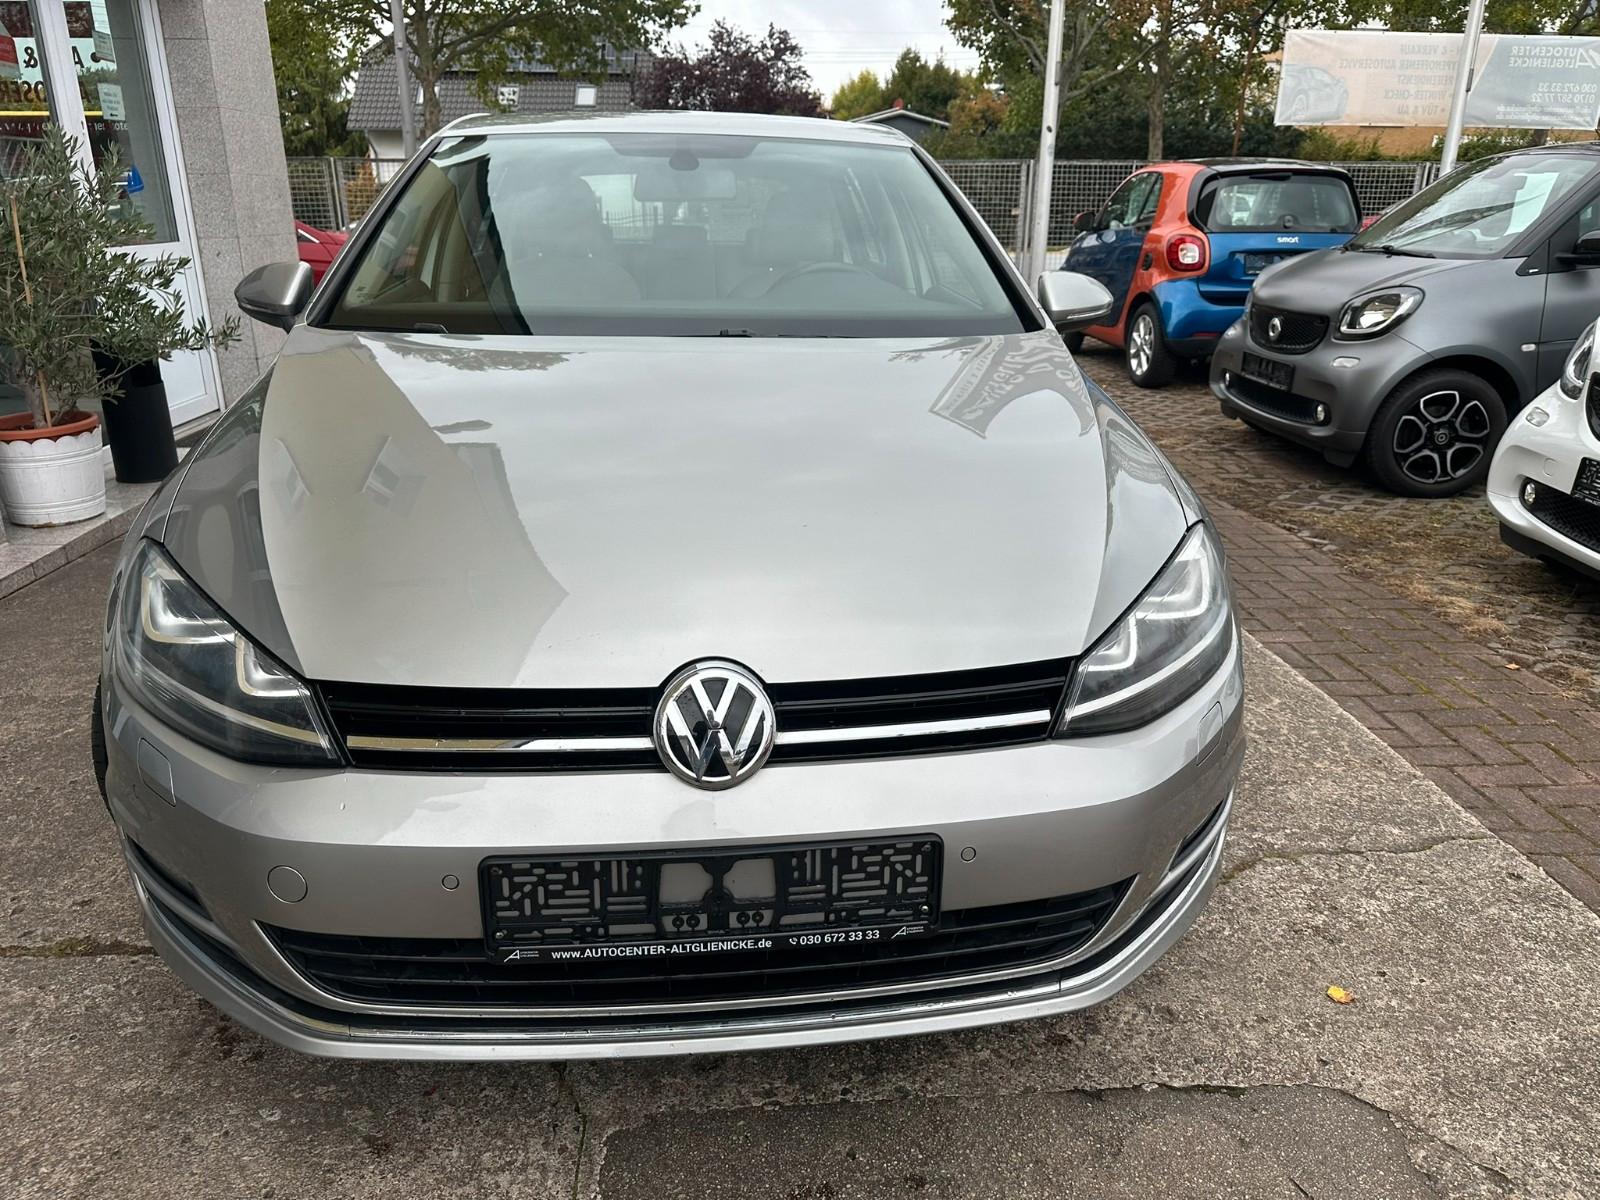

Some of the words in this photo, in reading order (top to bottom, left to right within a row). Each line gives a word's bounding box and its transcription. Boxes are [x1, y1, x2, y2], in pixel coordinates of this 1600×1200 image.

[1277, 236, 1299, 244] smart
[551, 938, 773, 960] www.AUTOCENTER-ALTGLIENICKE.de
[800, 935, 821, 945] 030
[824, 932, 846, 943] 672
[848, 930, 863, 941] 33
[865, 929, 880, 940] 33
